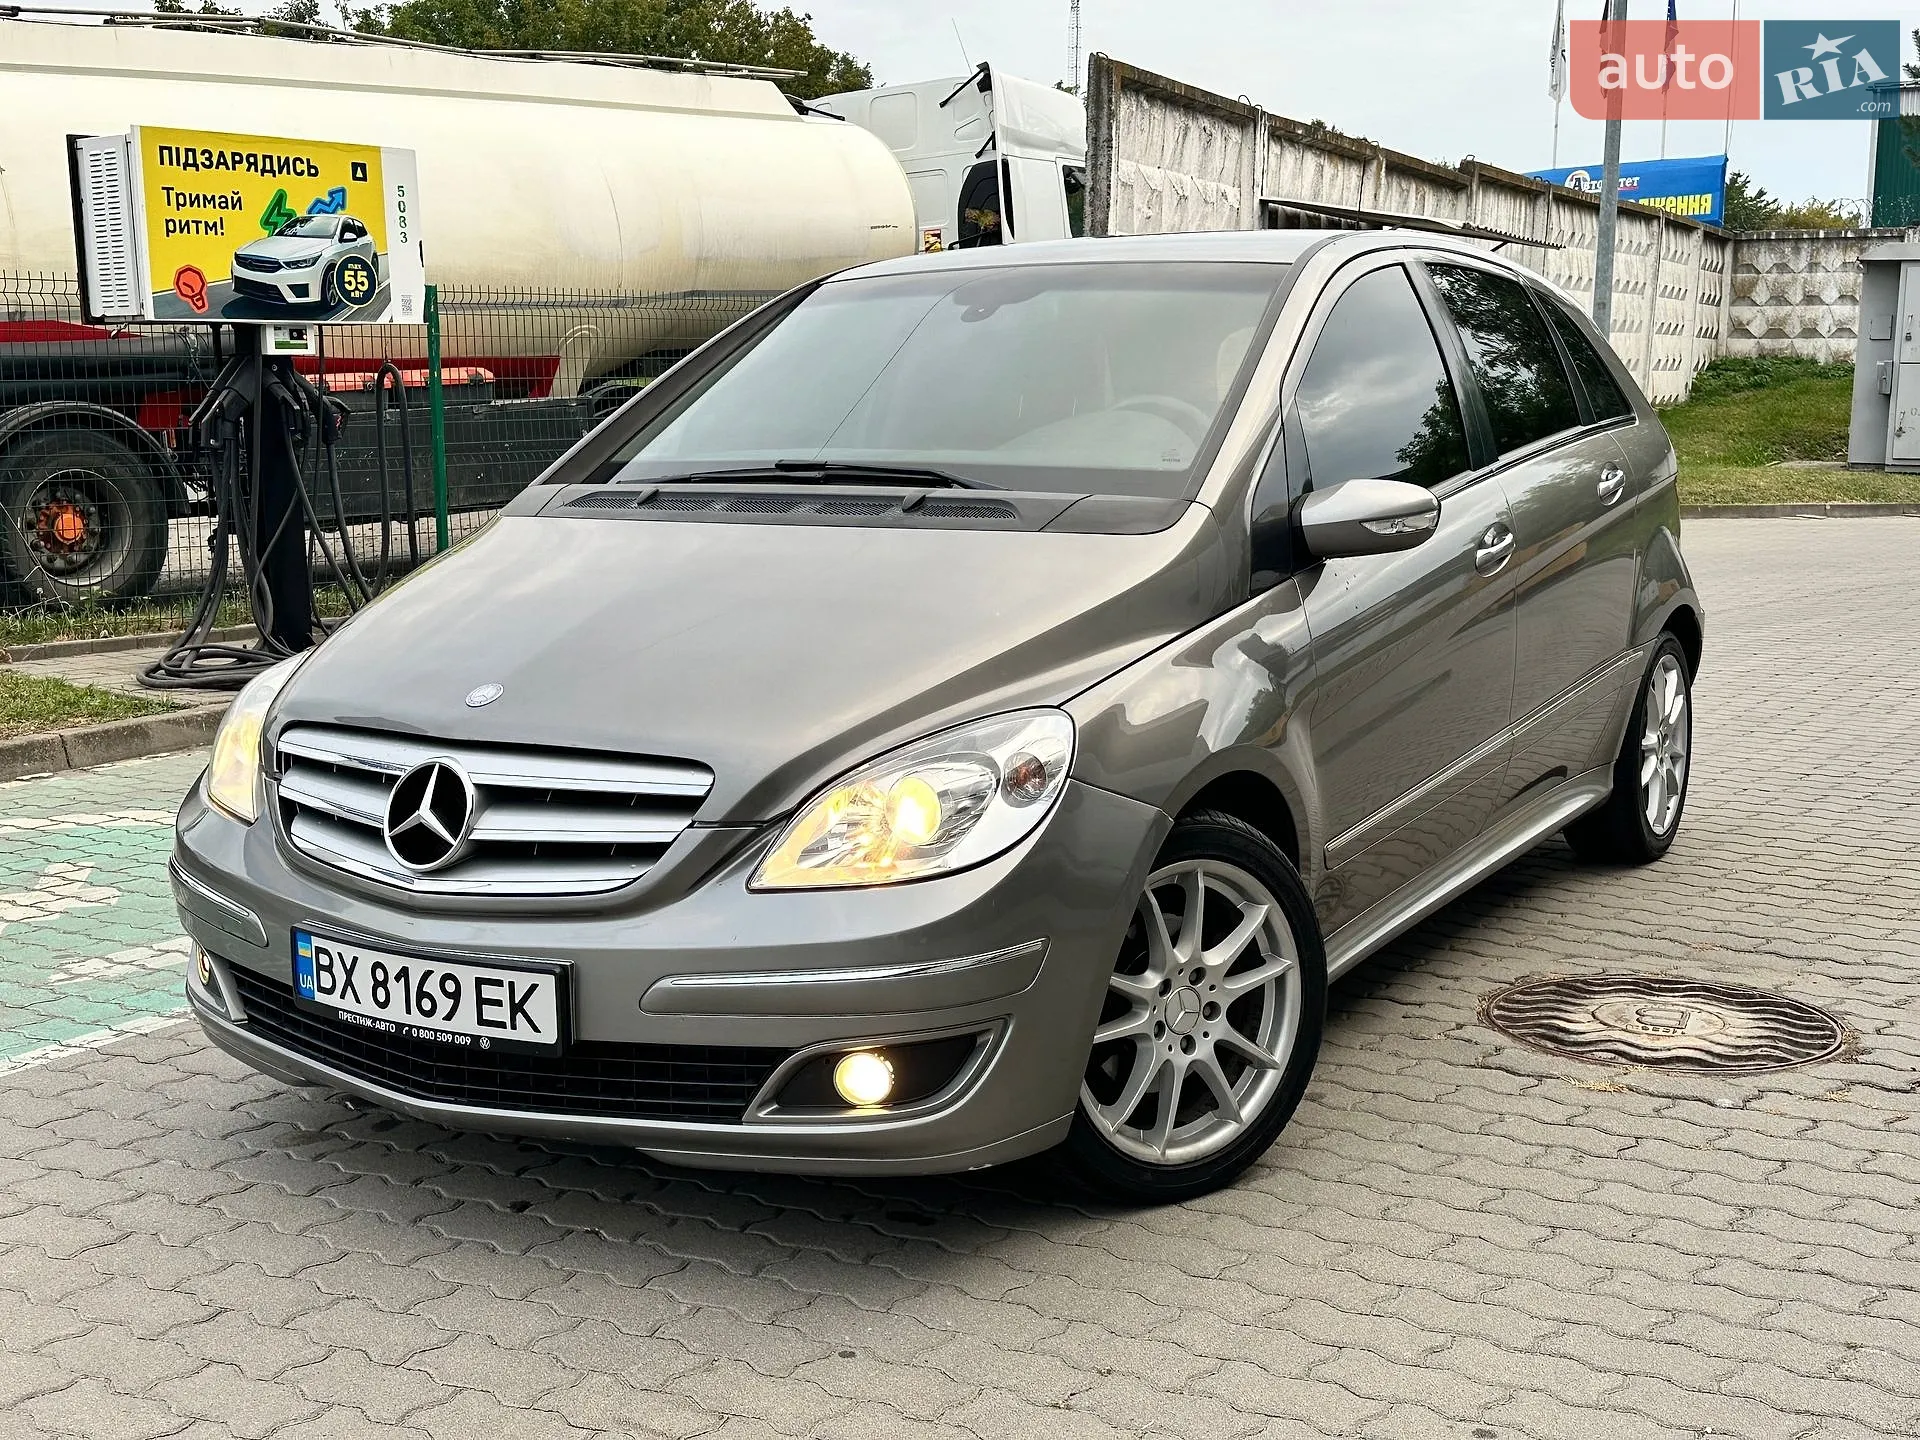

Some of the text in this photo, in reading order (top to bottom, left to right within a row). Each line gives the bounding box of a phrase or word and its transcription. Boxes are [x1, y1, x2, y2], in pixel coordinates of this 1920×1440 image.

[158, 145, 320, 178] ПІДЗАРЯДИСЬ
[1573, 176, 1640, 192] Автотет
[161, 186, 243, 212] Тримай
[165, 216, 225, 237] ритм!
[344, 270, 369, 291] 55
[299, 974, 314, 991] UA
[314, 945, 542, 1034] BX 8169 EK
[338, 1010, 396, 1033] ПРЕСТИЖ-АВТО
[411, 1027, 472, 1046] 0 800 509 009
